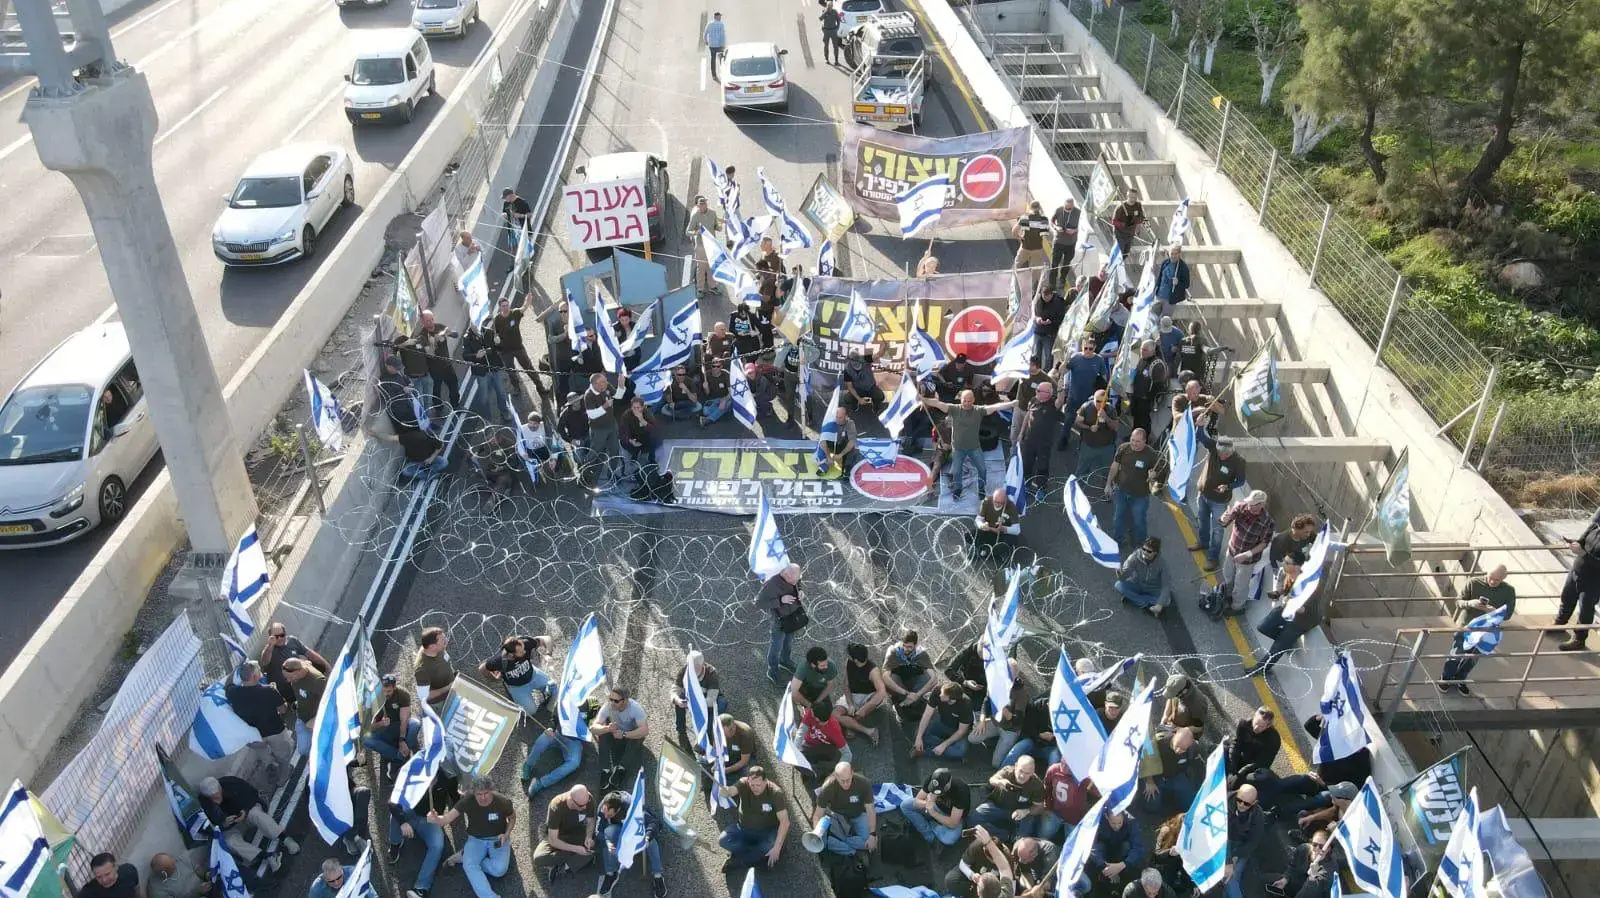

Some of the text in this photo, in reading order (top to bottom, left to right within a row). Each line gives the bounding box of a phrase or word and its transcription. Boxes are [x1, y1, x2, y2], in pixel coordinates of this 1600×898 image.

[566, 185, 644, 212] מעבר
[572, 214, 644, 243] גבול
[675, 479, 843, 497] גבול לפניך
